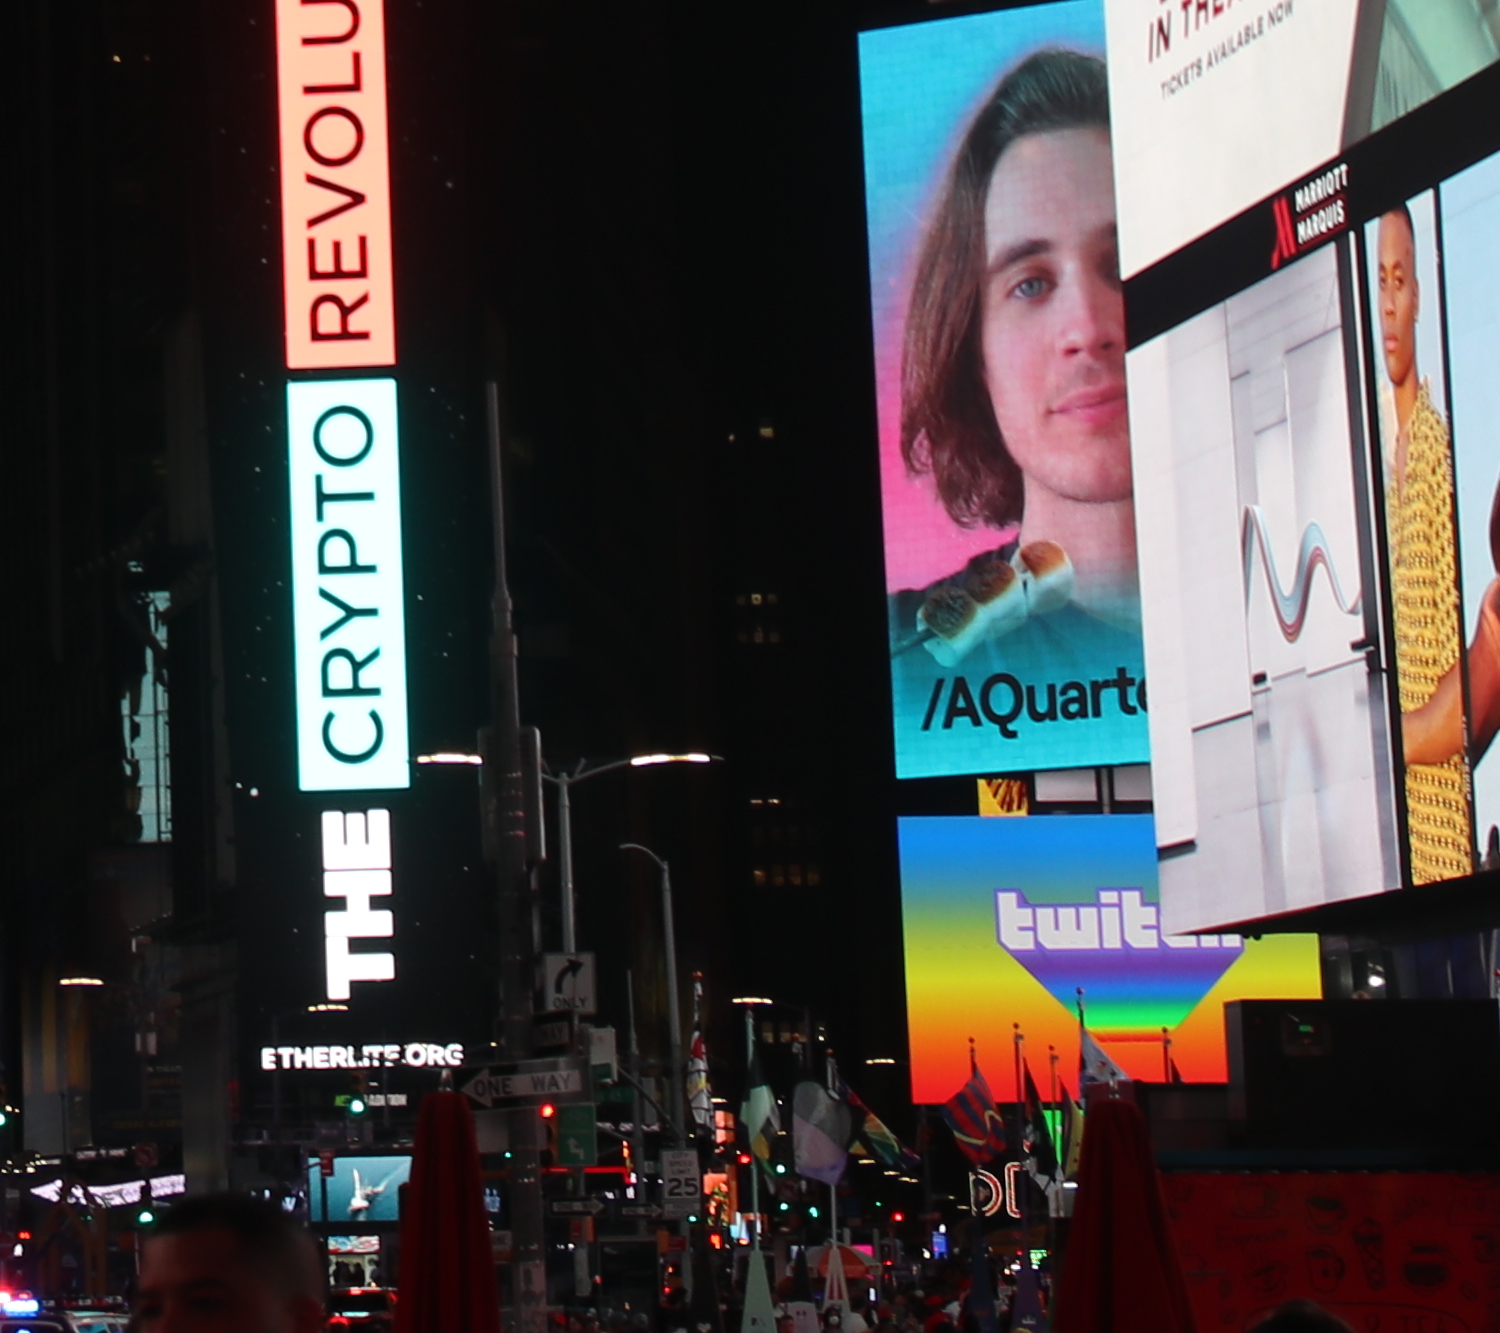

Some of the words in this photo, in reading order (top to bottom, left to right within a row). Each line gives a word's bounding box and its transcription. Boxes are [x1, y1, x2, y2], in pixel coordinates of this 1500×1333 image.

[1147, 7, 1173, 64] IN
[1160, 57, 1204, 101] TICKETS
[1206, 20, 1268, 80] AVAILABLE
[1293, 163, 1349, 215] MARRIOTT
[1296, 198, 1346, 246] MARQUIS
[312, 403, 384, 765] CRYPTO
[321, 808, 396, 1001] THE
[553, 996, 587, 1009] ONLY
[473, 1077, 513, 1098] ONE
[531, 1071, 574, 1094] WAY
[667, 1178, 699, 1198] 25
